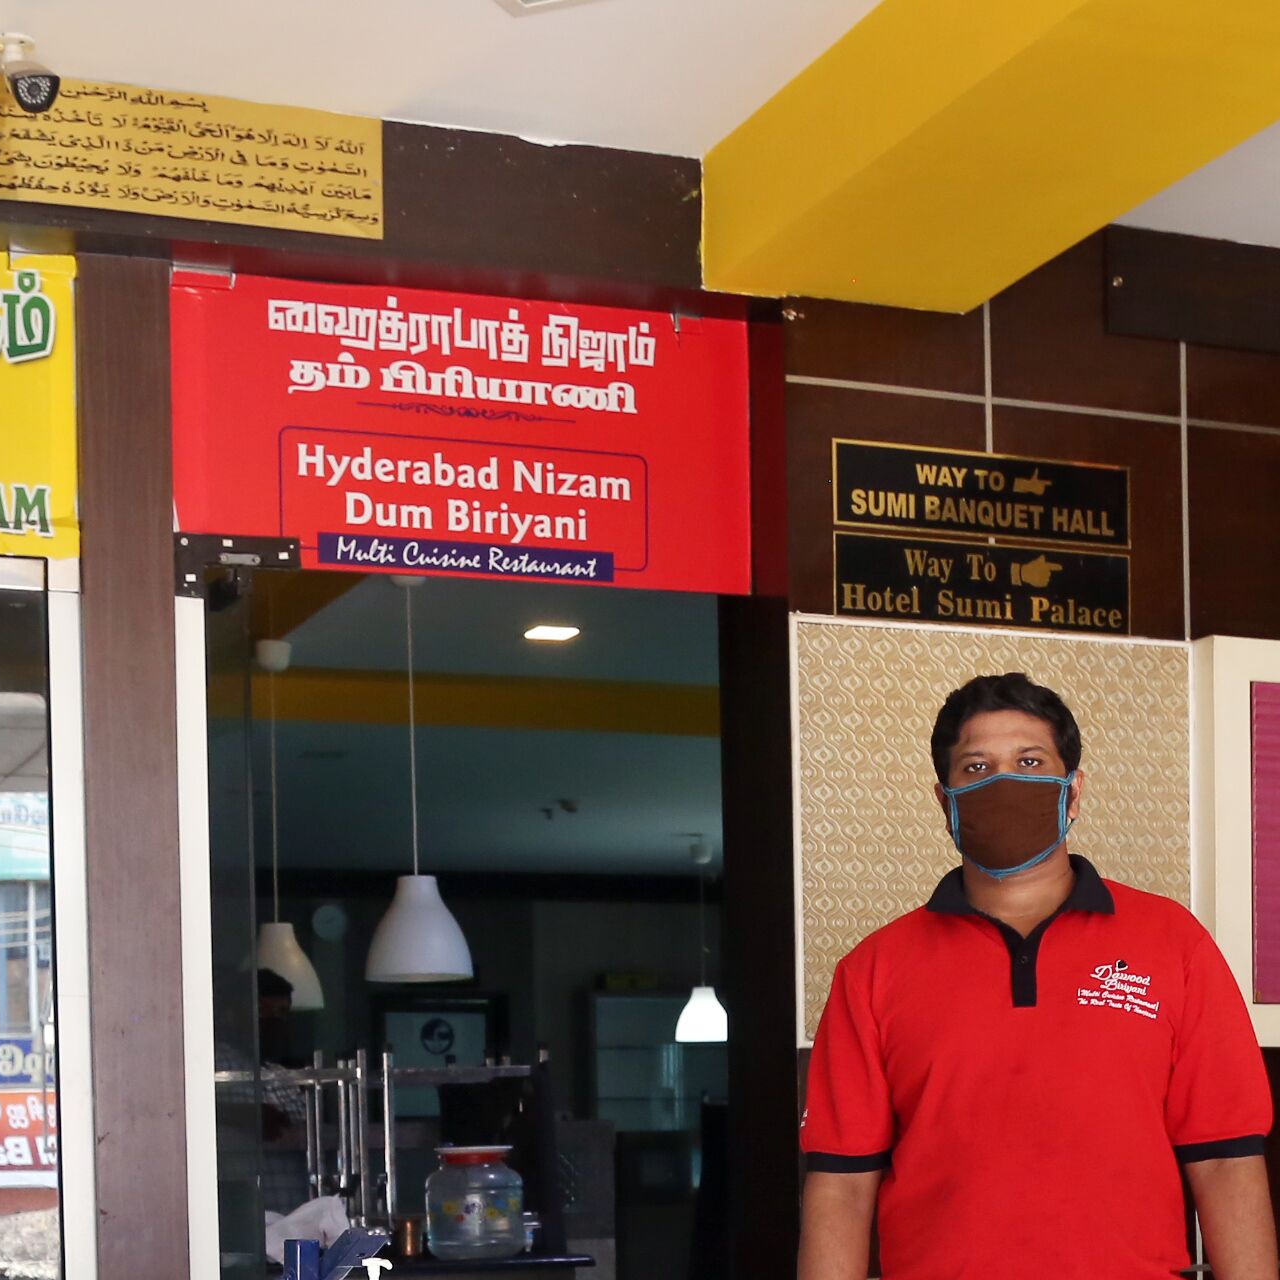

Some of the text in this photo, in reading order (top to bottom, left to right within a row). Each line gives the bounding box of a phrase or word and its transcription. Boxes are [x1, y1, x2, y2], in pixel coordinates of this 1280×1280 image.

[541, 314, 657, 373] நிஜாம்
[288, 351, 638, 414] தம் பிரியாணி
[296, 443, 632, 502] Hyderabad Nizam
[916, 463, 1005, 491] WAY TO
[345, 491, 588, 544] Dum Biriyani
[851, 489, 1115, 537] SUMI BANQUET HALL
[336, 536, 597, 579] Multi Cuisine Restaurant
[904, 549, 997, 583] Way To
[841, 583, 1122, 628] Hotel Sumi Palace
[1090, 964, 1151, 986] Dawood
